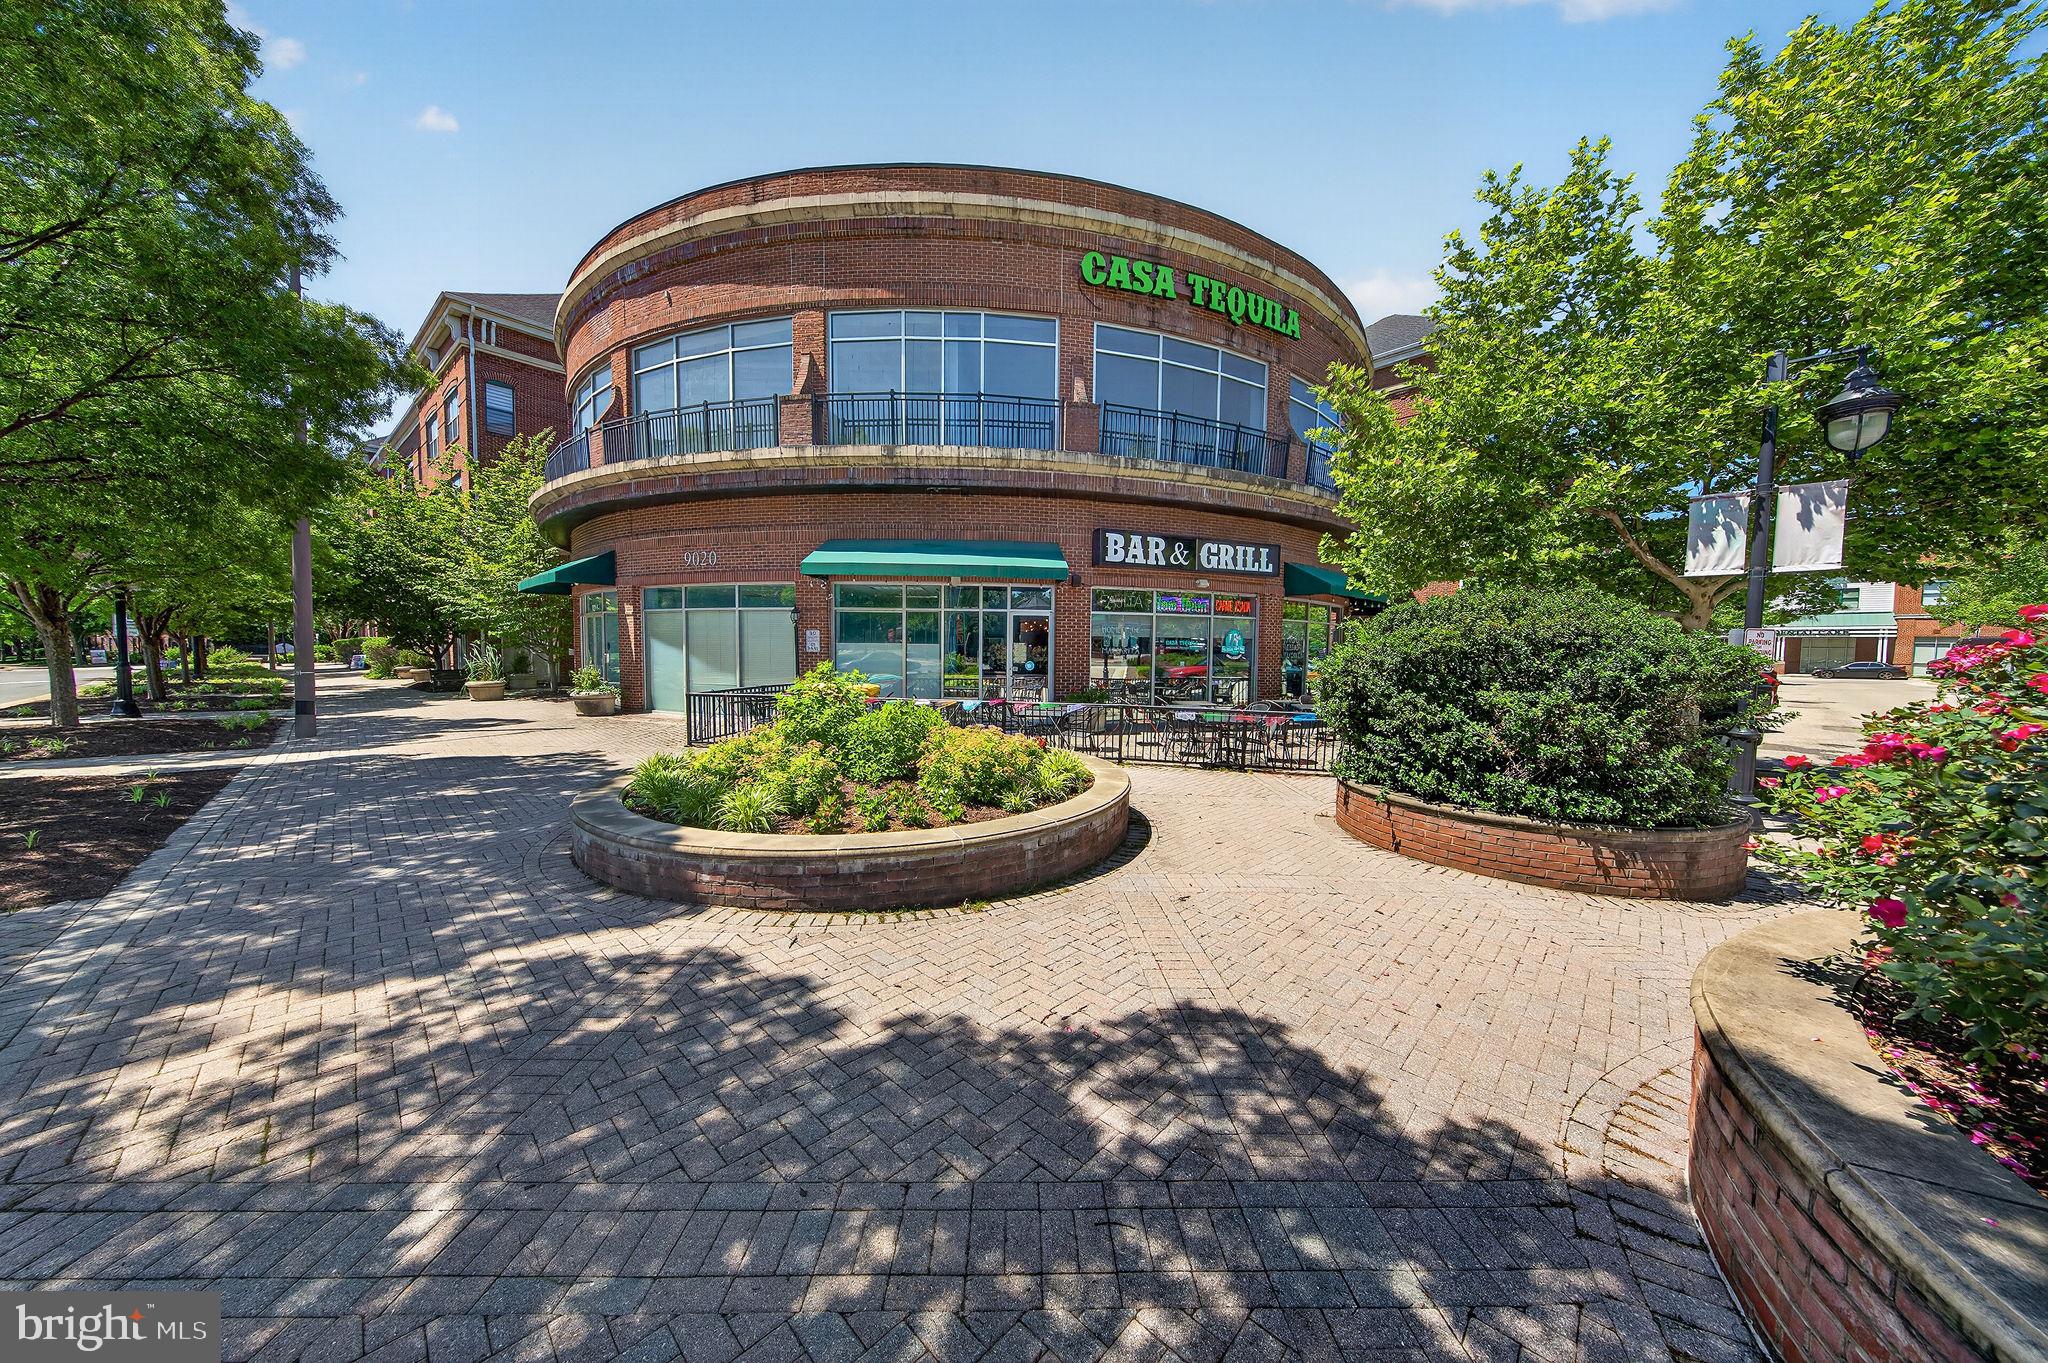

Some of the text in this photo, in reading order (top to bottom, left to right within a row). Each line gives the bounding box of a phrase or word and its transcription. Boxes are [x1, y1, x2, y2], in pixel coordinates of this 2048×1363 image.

[1080, 251, 1301, 340] CASA TEQUILA
[684, 550, 717, 567] 9020
[1105, 532, 1273, 573] BAR & GRILL
